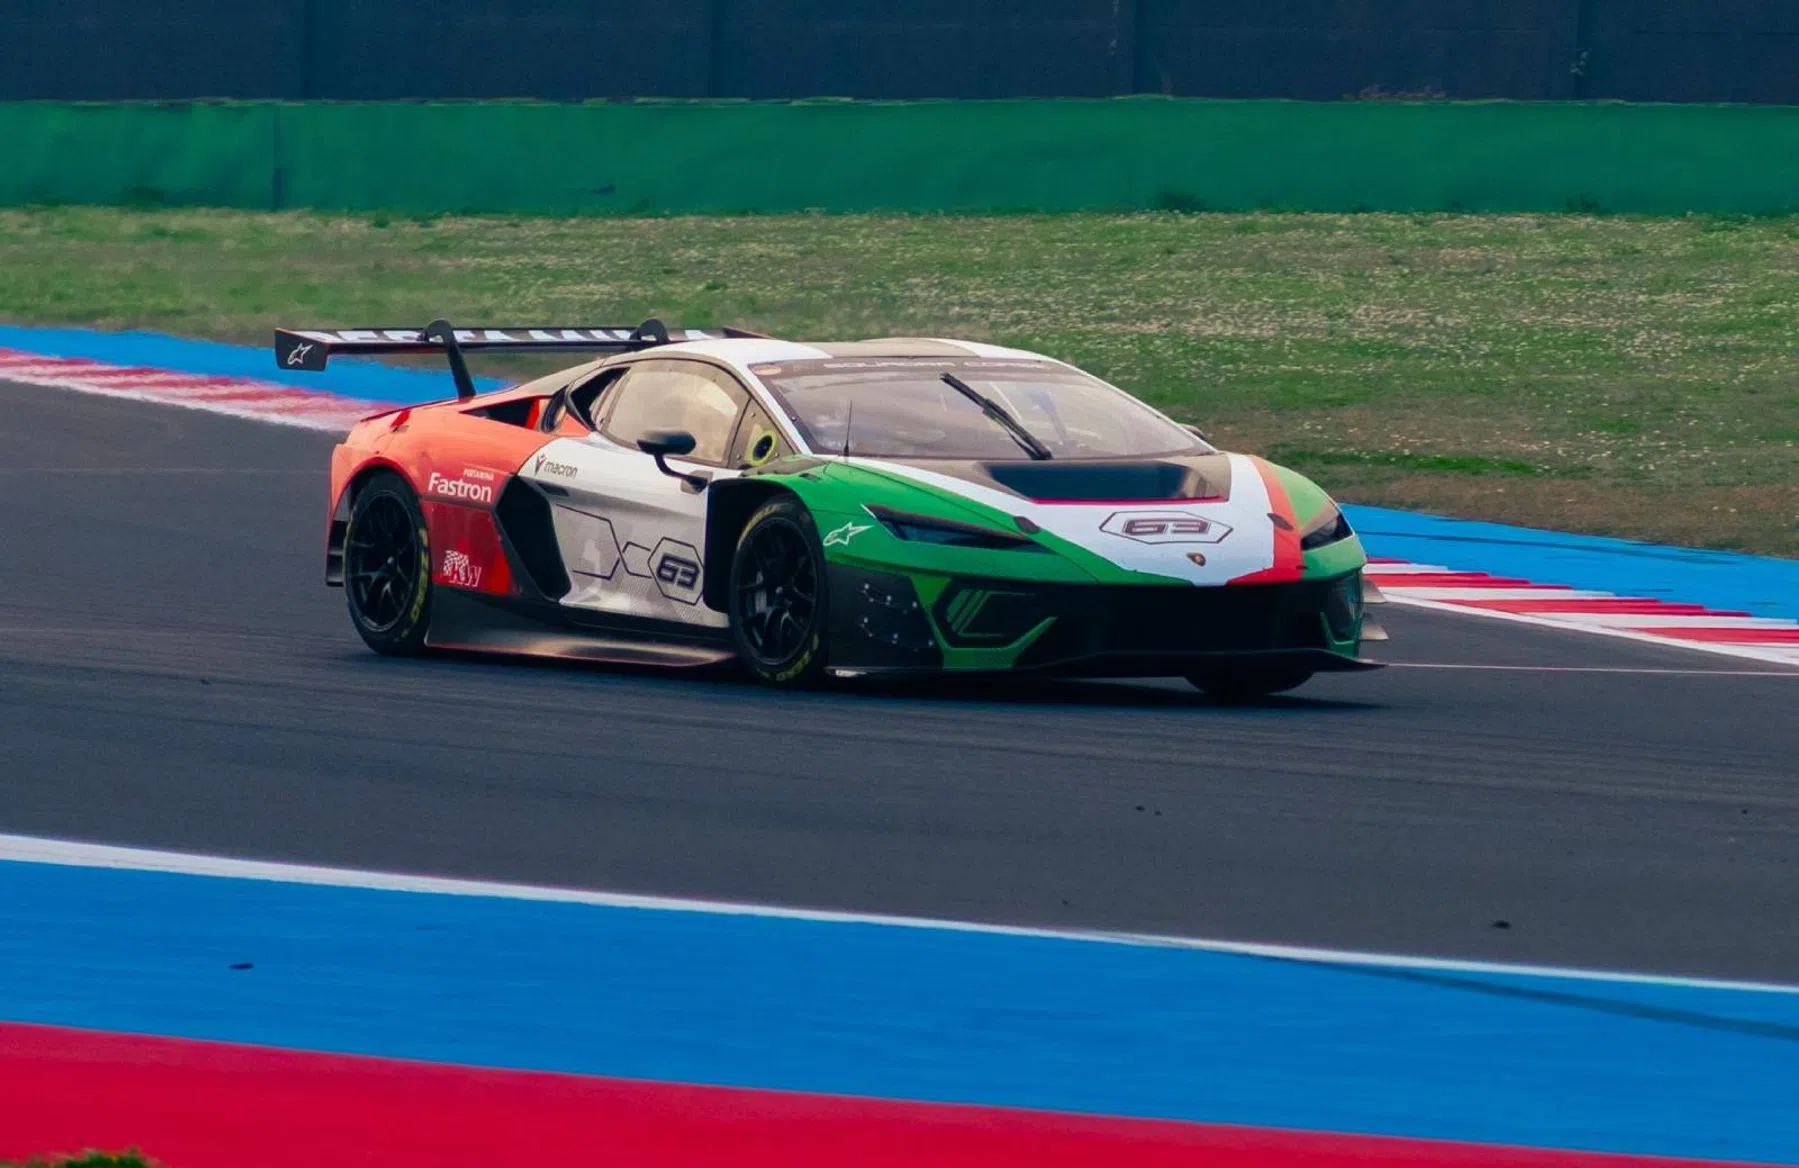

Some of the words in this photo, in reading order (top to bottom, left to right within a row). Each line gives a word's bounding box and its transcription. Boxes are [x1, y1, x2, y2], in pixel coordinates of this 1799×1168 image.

[544, 461, 578, 478] macron
[428, 472, 492, 502] Fastron
[1122, 518, 1212, 536] 63
[656, 553, 700, 591] 63
